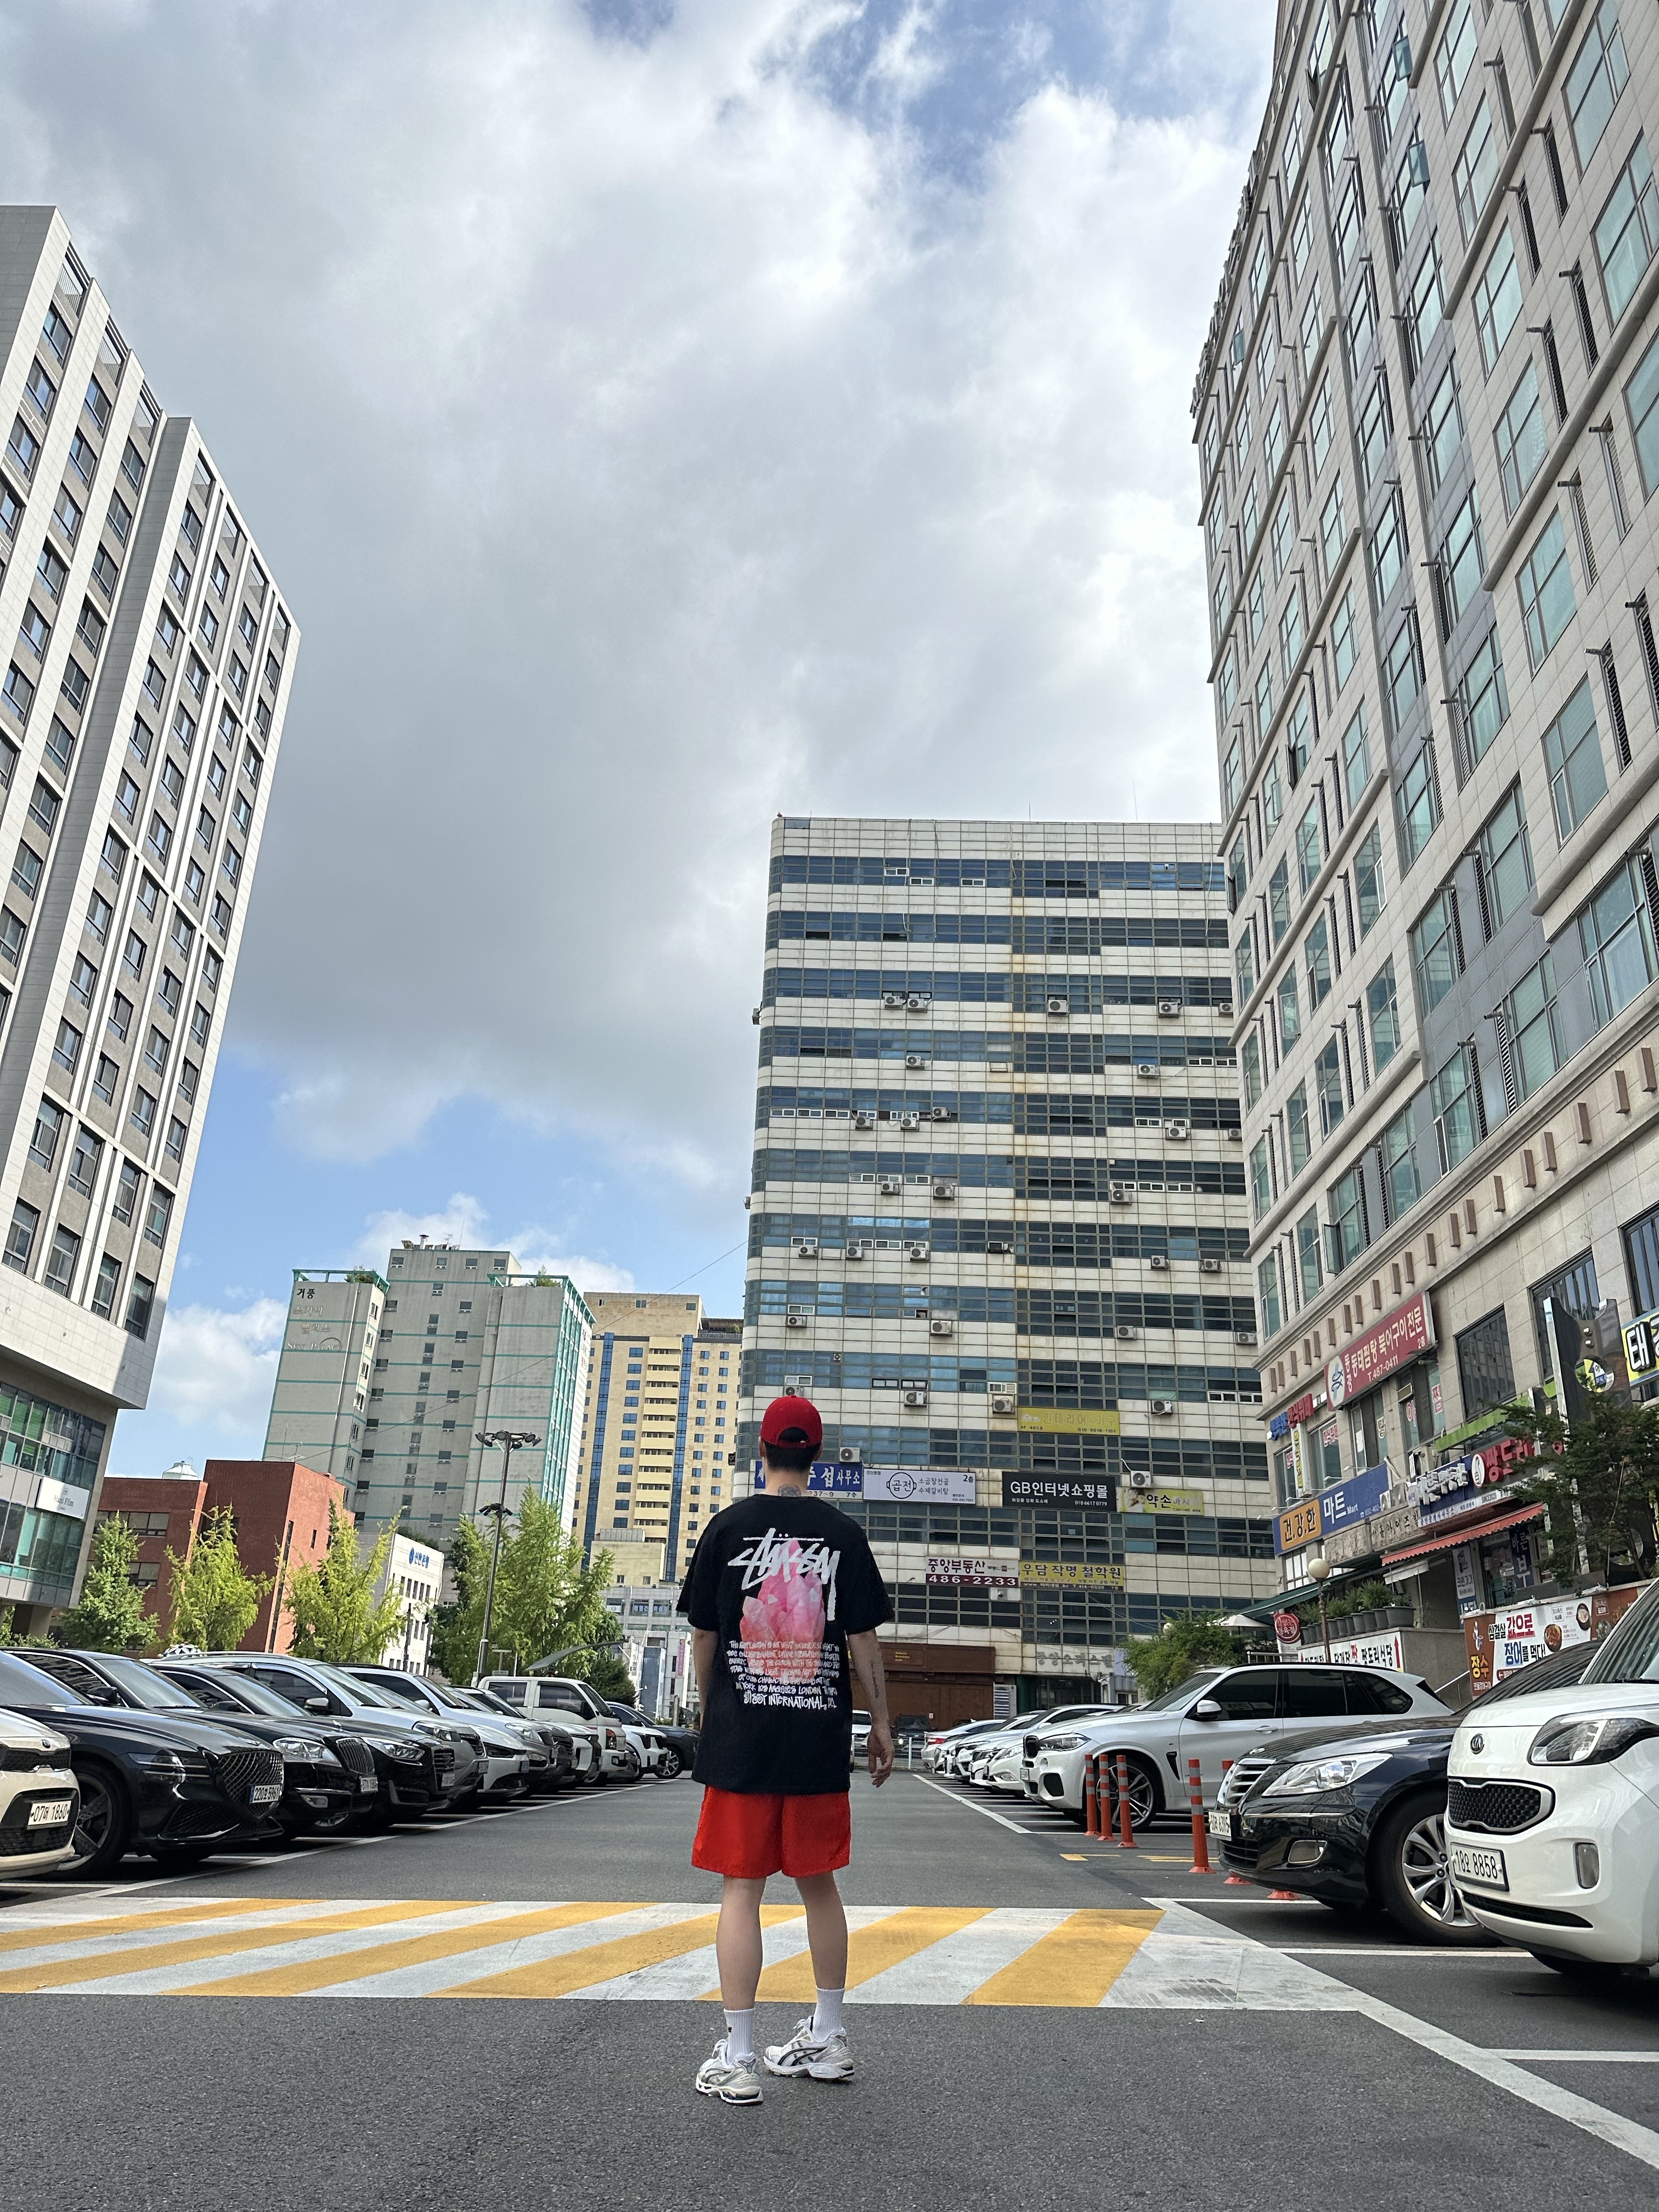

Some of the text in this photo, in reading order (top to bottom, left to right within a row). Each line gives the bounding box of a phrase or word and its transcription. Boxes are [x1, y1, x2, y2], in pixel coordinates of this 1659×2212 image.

[297, 1288, 315, 1299] 거풍
[293, 1306, 324, 1317] 스카이
[1407, 1306, 1423, 1338] 전문
[1417, 1335, 1425, 1349] 2층
[836, 1469, 860, 1486] 사무소
[963, 1475, 974, 1483] 2층
[892, 1480, 911, 1492] 곱전
[1010, 1481, 1108, 1499] GB인터넷쇼핑몰
[1147, 1494, 1172, 1508] 약손
[1323, 1491, 1346, 1524] 마트
[1347, 1503, 1358, 1515] Mart
[928, 1559, 985, 1574] 중앙부동산
[1022, 1564, 1121, 1579] 우담 작명 철학원
[929, 1575, 1016, 1585] 486-2233
[1036, 1651, 1113, 1668] 중앙오피스텔
[1504, 1641, 1529, 1666] 장어를
[1471, 1655, 1490, 1679] 장수
[52, 1804, 67, 1820] 1860
[1455, 1849, 1498, 1879] 18오 8858
